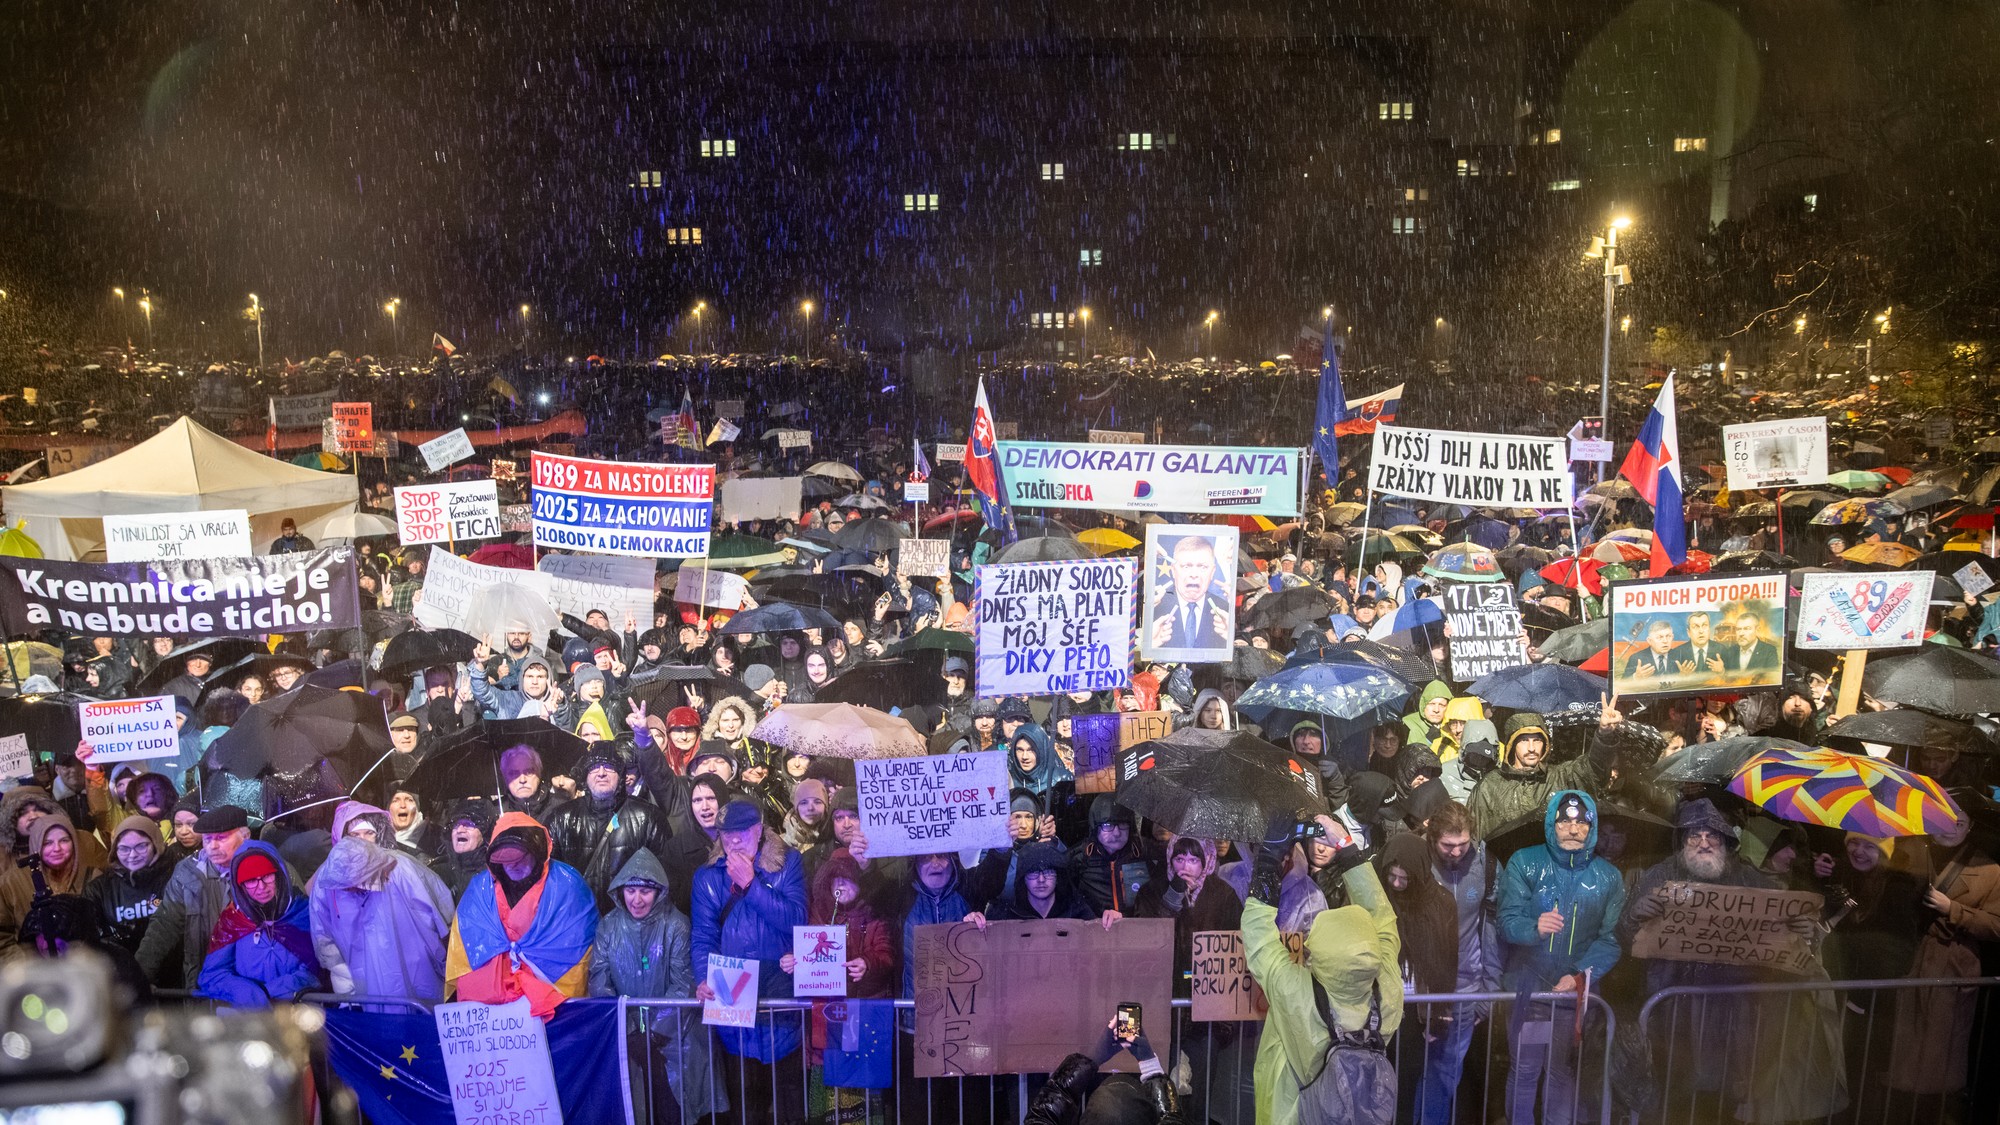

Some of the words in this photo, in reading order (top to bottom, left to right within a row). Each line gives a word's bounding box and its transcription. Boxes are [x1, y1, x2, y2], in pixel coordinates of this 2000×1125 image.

[348, 418, 360, 426] DO
[1727, 427, 1784, 440] PREVERENÝ
[1788, 426, 1822, 434] ČASOM
[939, 444, 965, 453] SLOBODA
[1382, 431, 1432, 463] VYŠŠÍ
[1441, 439, 1472, 468] DLH
[1480, 442, 1500, 470] AJ
[1506, 444, 1554, 471] DANE
[1004, 447, 1156, 472] DEMOKRATI
[1162, 452, 1288, 476] GALANTA
[534, 459, 578, 489] 1989
[584, 470, 602, 490] ZA
[608, 471, 710, 494] NASTOLENIE
[1376, 462, 1436, 496] ZRÁŽKY
[1444, 473, 1504, 500] VLAKOV
[1514, 478, 1534, 502] ZA
[1540, 478, 1563, 502] NE
[401, 491, 440, 508] STOP
[1207, 488, 1263, 498] REFERENDUM
[404, 508, 442, 524] STOP
[535, 493, 579, 523] 2025
[583, 502, 602, 523] ZA
[605, 504, 708, 528] ZACHOVANIE
[112, 524, 171, 543] MINULOST
[178, 524, 197, 542] SA
[201, 522, 240, 538] VRACIA
[406, 522, 444, 542] STOP
[456, 516, 500, 539] FICA!
[536, 526, 596, 548] SLOBODY
[610, 534, 706, 554] DEMOKRACIE
[544, 560, 570, 572] MY
[576, 561, 616, 580] SME
[994, 568, 1063, 596] ŽIADNY
[1069, 564, 1128, 590] SOROS.
[16, 568, 216, 604] Kremnica
[225, 567, 287, 600] nie
[293, 562, 330, 600] je
[428, 570, 482, 598] DEMOKR
[687, 586, 700, 599] TY
[423, 590, 464, 612] NIKDY
[1447, 585, 1474, 611] 17.
[1624, 591, 1646, 608] PO
[1652, 588, 1690, 607] NICH
[1696, 582, 1778, 604] POTOPA!!!
[1851, 580, 1888, 613] 89
[26, 602, 52, 625] a
[57, 605, 214, 635] nebude
[222, 593, 333, 631] ticho!
[982, 596, 1028, 624] DNES
[1038, 594, 1068, 620] MA
[1074, 590, 1128, 618] PLATÍ
[1874, 598, 1912, 638] SLOBODA
[1875, 594, 1900, 623] 2025
[1002, 621, 1048, 648] MÔJ
[1060, 618, 1100, 647] ŠÉF.
[1447, 610, 1523, 638] NOVEMBER
[1005, 646, 1056, 676] DÍKY
[1064, 643, 1113, 672] PEŤO.
[1451, 640, 1490, 658] SLOBODA
[1508, 638, 1520, 656] JE
[1047, 674, 1080, 692] (NIE
[1085, 668, 1126, 689] TEN)
[1452, 660, 1471, 678] DAR
[1472, 660, 1490, 678] ALE
[146, 701, 162, 712] SA
[88, 722, 114, 736] BOJÍ
[118, 721, 160, 734] HLASU
[164, 719, 173, 730] A
[1126, 716, 1168, 740] THEY
[138, 738, 172, 750] ĽUDU
[1138, 750, 1154, 760] I
[864, 764, 882, 778] NA
[886, 759, 926, 777] ÚRADE
[932, 755, 977, 773] VLÁDY
[1124, 751, 1138, 780] PARIS
[860, 776, 896, 794] EŠTE
[900, 774, 946, 792] STÁLE
[864, 788, 936, 810] OSLAVUJÚ
[942, 788, 980, 804] VOSR
[868, 812, 890, 826] MY
[892, 809, 916, 825] ALE
[920, 806, 958, 822] VIEME
[962, 804, 986, 819] KDE
[990, 800, 1008, 816] JE
[904, 820, 956, 840] "SEVER"
[1657, 884, 1755, 914] SÚDRUH
[1765, 898, 1815, 918] FICO
[1662, 910, 1697, 926] VOJ
[1708, 914, 1784, 933] KONIEC
[1661, 925, 1687, 936] SA
[1696, 927, 1772, 946] ZAČAL
[1658, 937, 1669, 950] V
[1680, 940, 1790, 964] POPRADE
[710, 955, 747, 970] NEŽNÁ
[810, 970, 829, 978] nám
[1194, 958, 1225, 976] MOJI
[798, 982, 842, 990] nesiahaj!!!
[1193, 977, 1226, 996] ROKU
[1228, 974, 1252, 1014] 19
[942, 922, 988, 1076] SMER
[442, 1022, 488, 1039] JEDNOTA
[492, 1016, 524, 1031] ĽUDU
[448, 1039, 481, 1055] VÍTAJ
[486, 1034, 536, 1052] SLOBODA
[465, 1059, 508, 1078] 2025
[456, 1076, 526, 1100] NEDAJME
[474, 1099, 488, 1112] SI
[494, 1094, 514, 1111] JU
